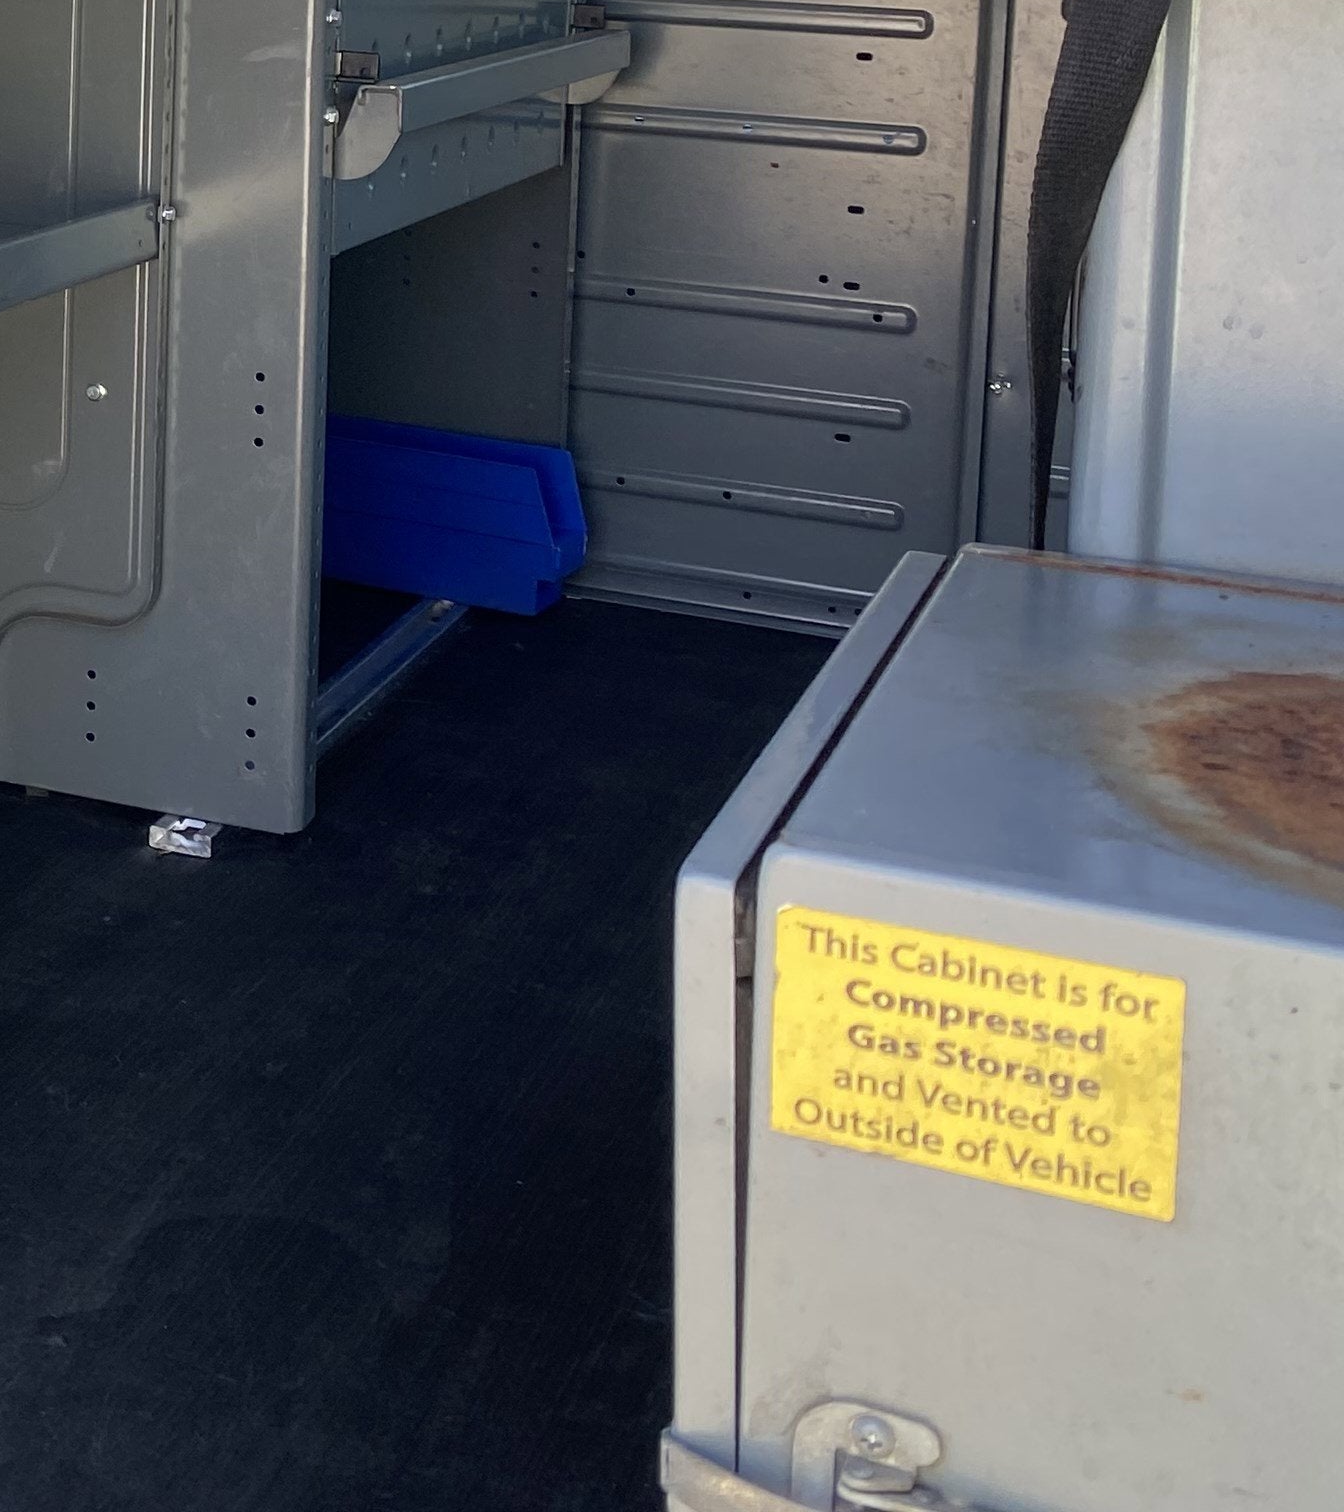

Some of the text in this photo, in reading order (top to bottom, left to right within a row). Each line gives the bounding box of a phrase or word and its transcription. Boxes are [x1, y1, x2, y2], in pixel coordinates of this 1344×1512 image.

[800, 922, 1159, 1021] This Cabinet is for
[845, 979, 1106, 1054] Compressed
[847, 1023, 1102, 1100] Gas Storage
[833, 1068, 1112, 1148] and Vented to
[793, 1097, 1153, 1203] Outside of Vehicle
